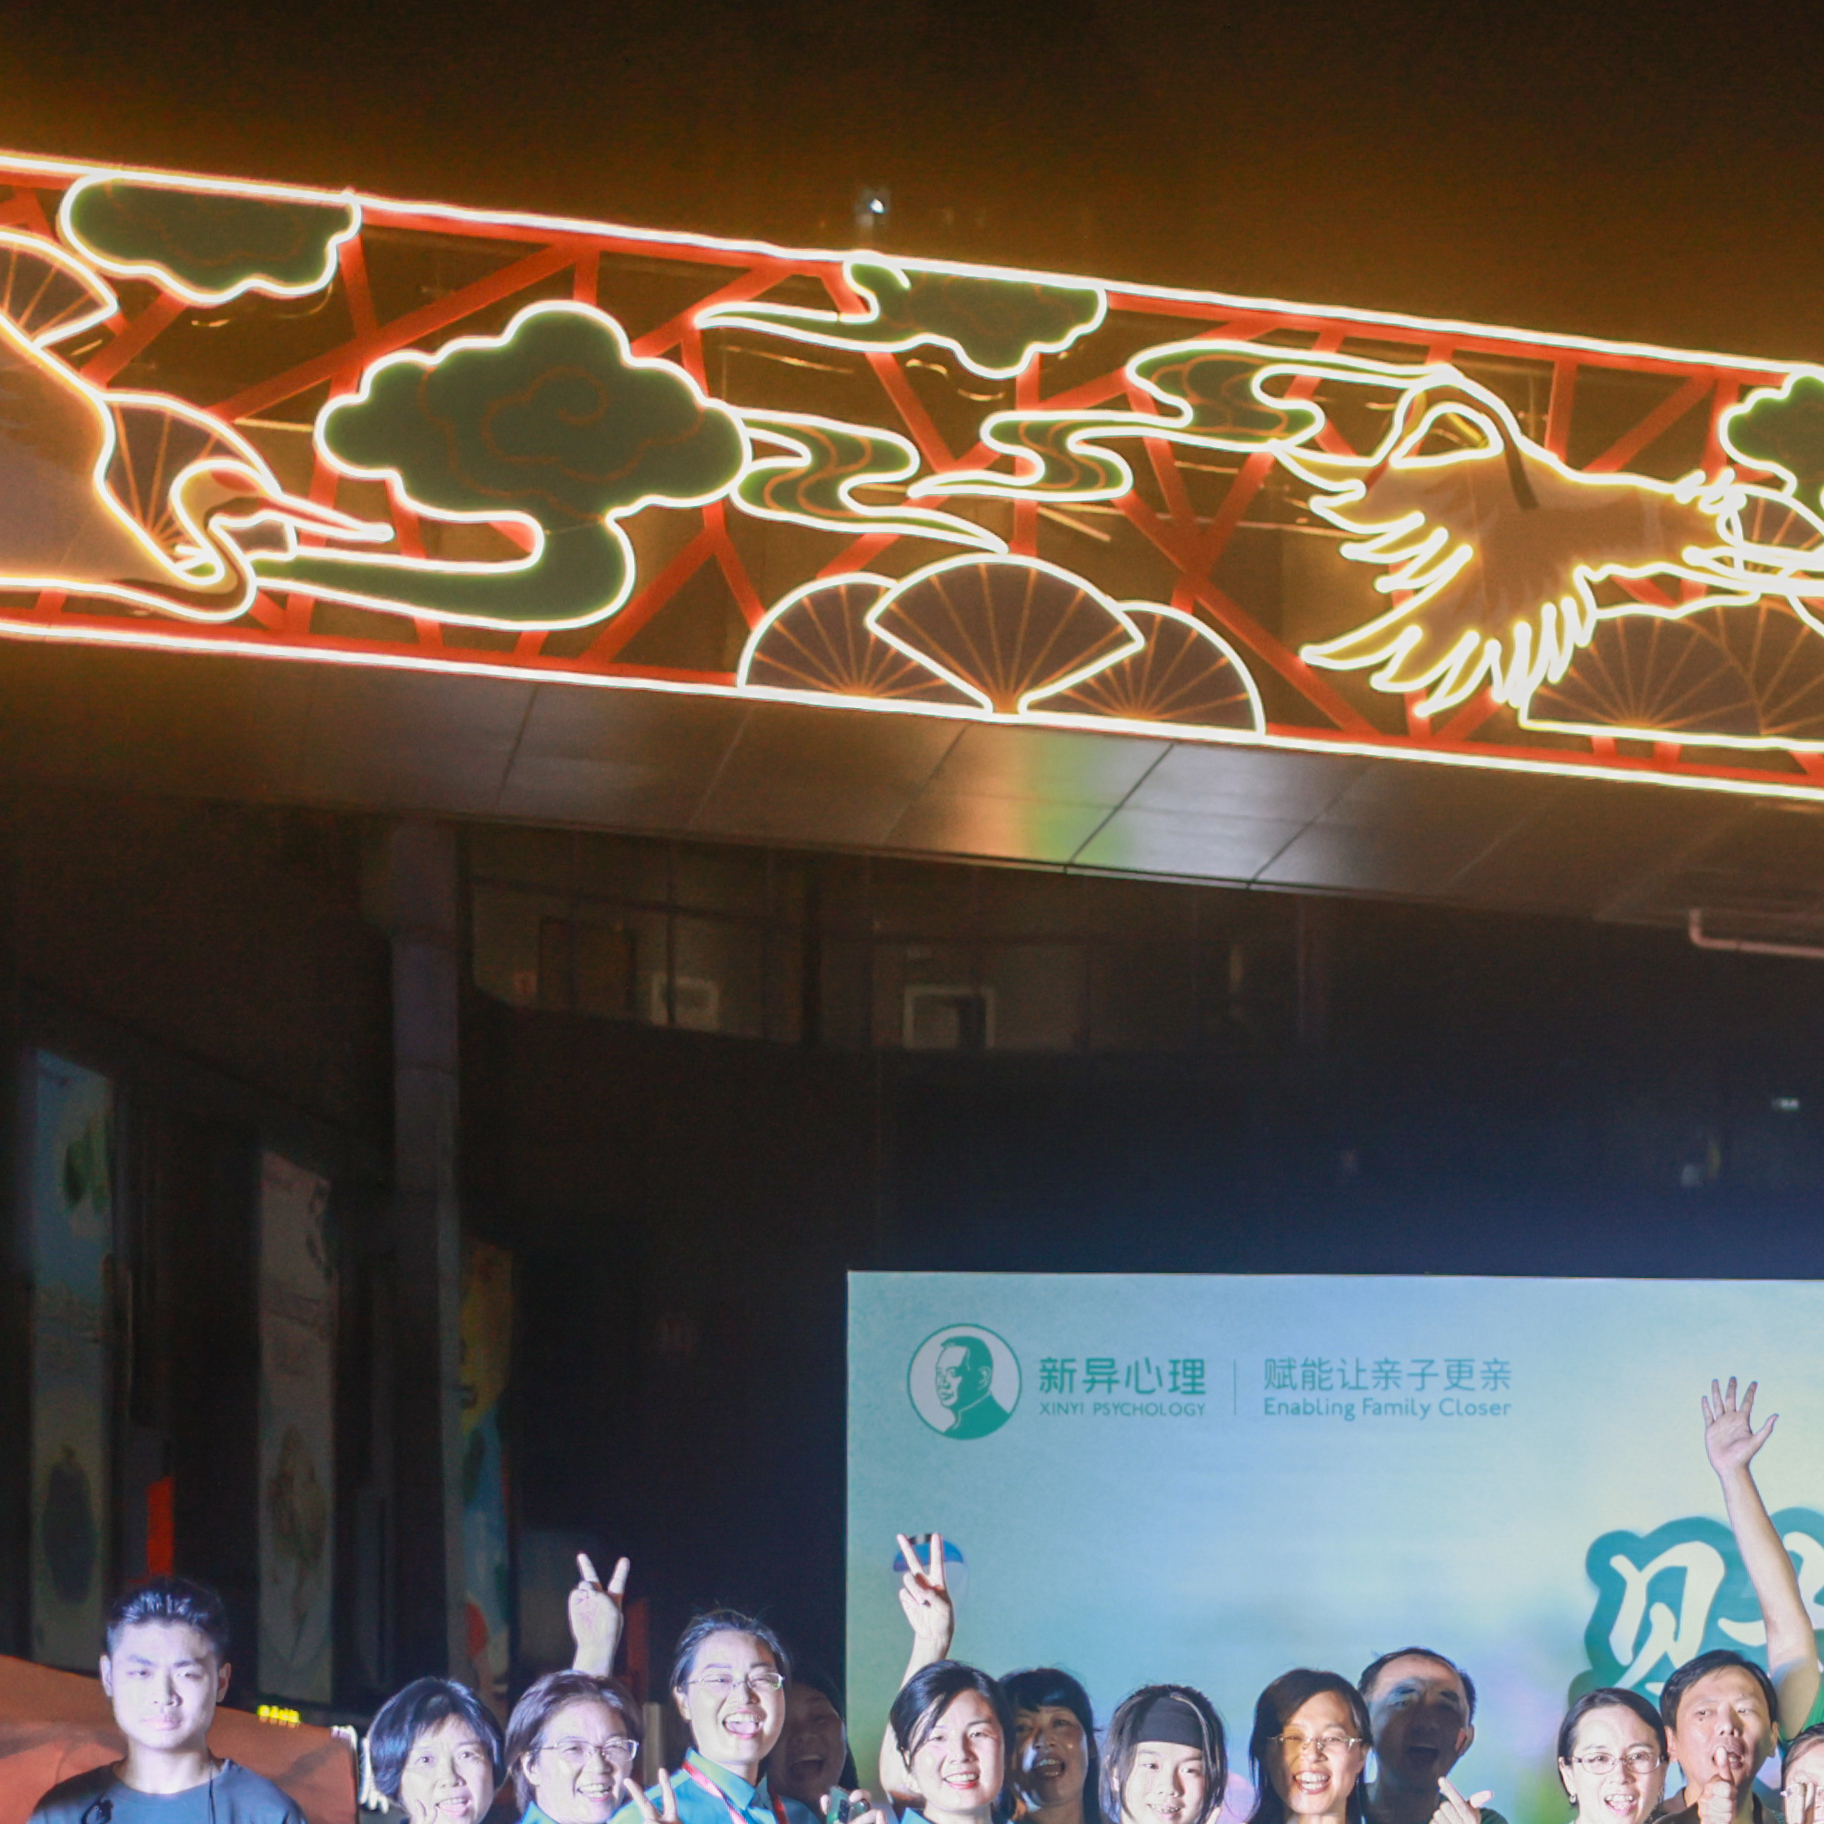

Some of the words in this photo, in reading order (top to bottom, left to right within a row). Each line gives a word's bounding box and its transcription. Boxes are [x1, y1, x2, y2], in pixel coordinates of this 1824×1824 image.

[1038, 1357, 1206, 1396] 新异心理
[1263, 1357, 1512, 1393] 赋能让亲子更亲
[1039, 1402, 1085, 1417] XINYI
[1093, 1402, 1206, 1417] PSYCHOLOGY
[1263, 1397, 1355, 1424] Enabling
[1362, 1397, 1431, 1422] Family
[1439, 1397, 1513, 1418] Closer
